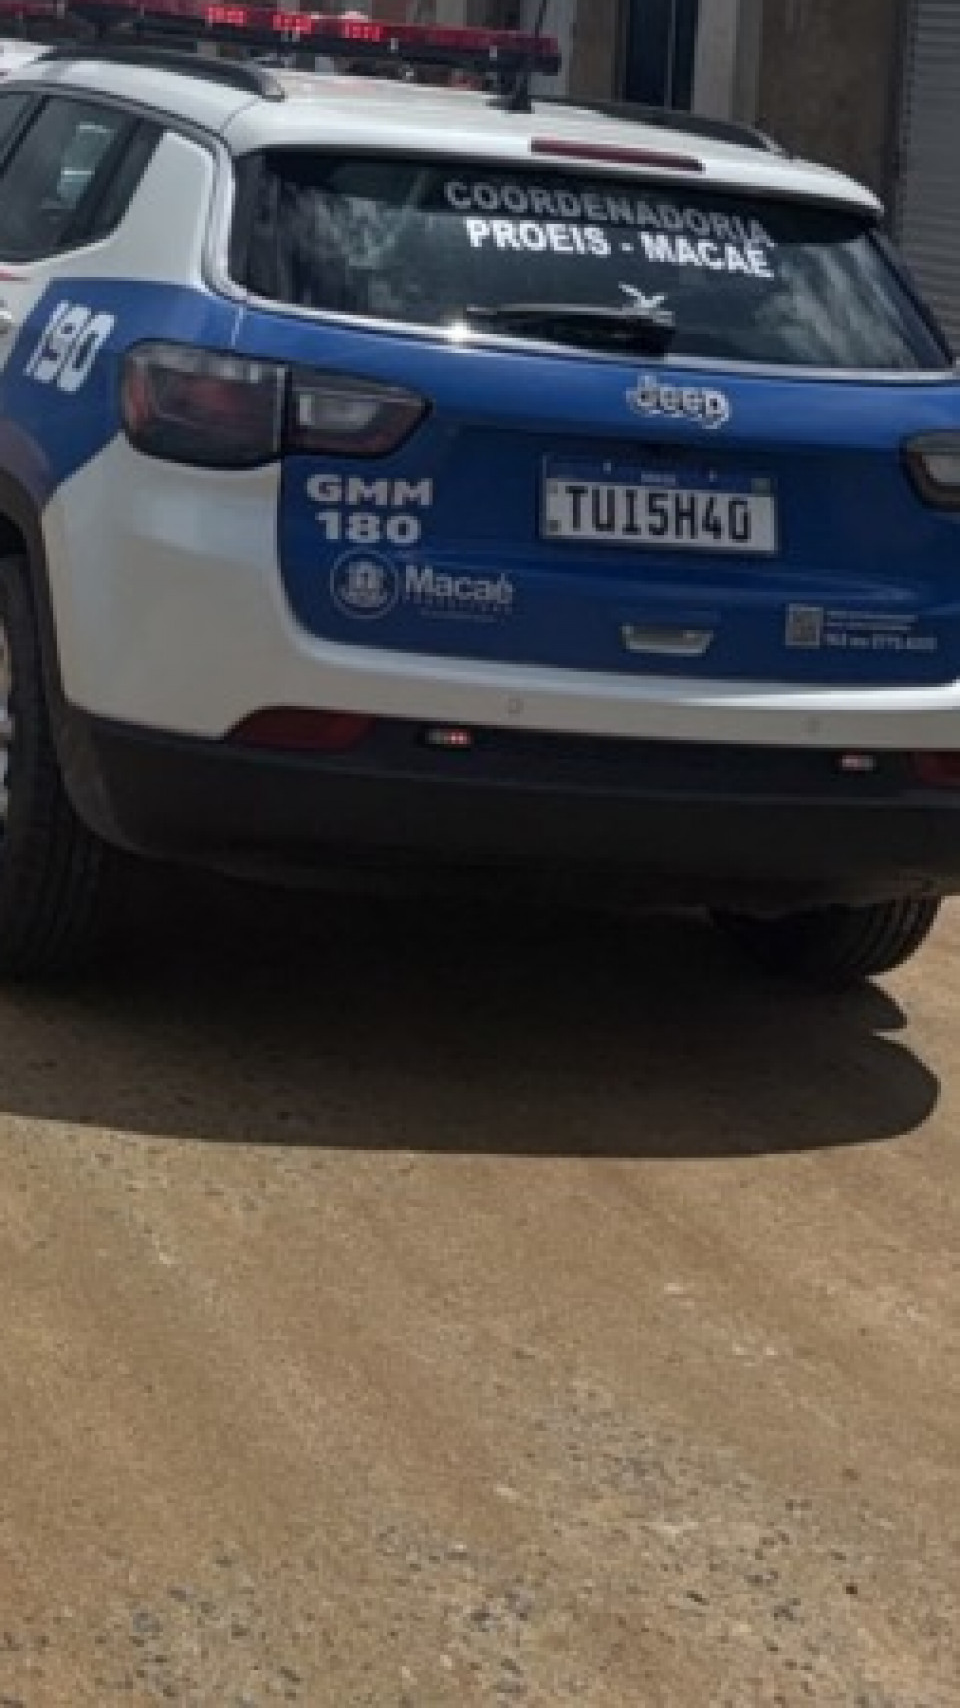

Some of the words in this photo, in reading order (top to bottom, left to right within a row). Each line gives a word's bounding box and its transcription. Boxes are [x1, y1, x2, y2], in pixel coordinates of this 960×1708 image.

[444, 181, 774, 246] COORDENADORIA
[466, 218, 611, 256] PROEIS
[23, 300, 115, 393] 190
[306, 474, 432, 506] GMM
[316, 511, 421, 544] 180
[405, 566, 514, 603] Macaé
